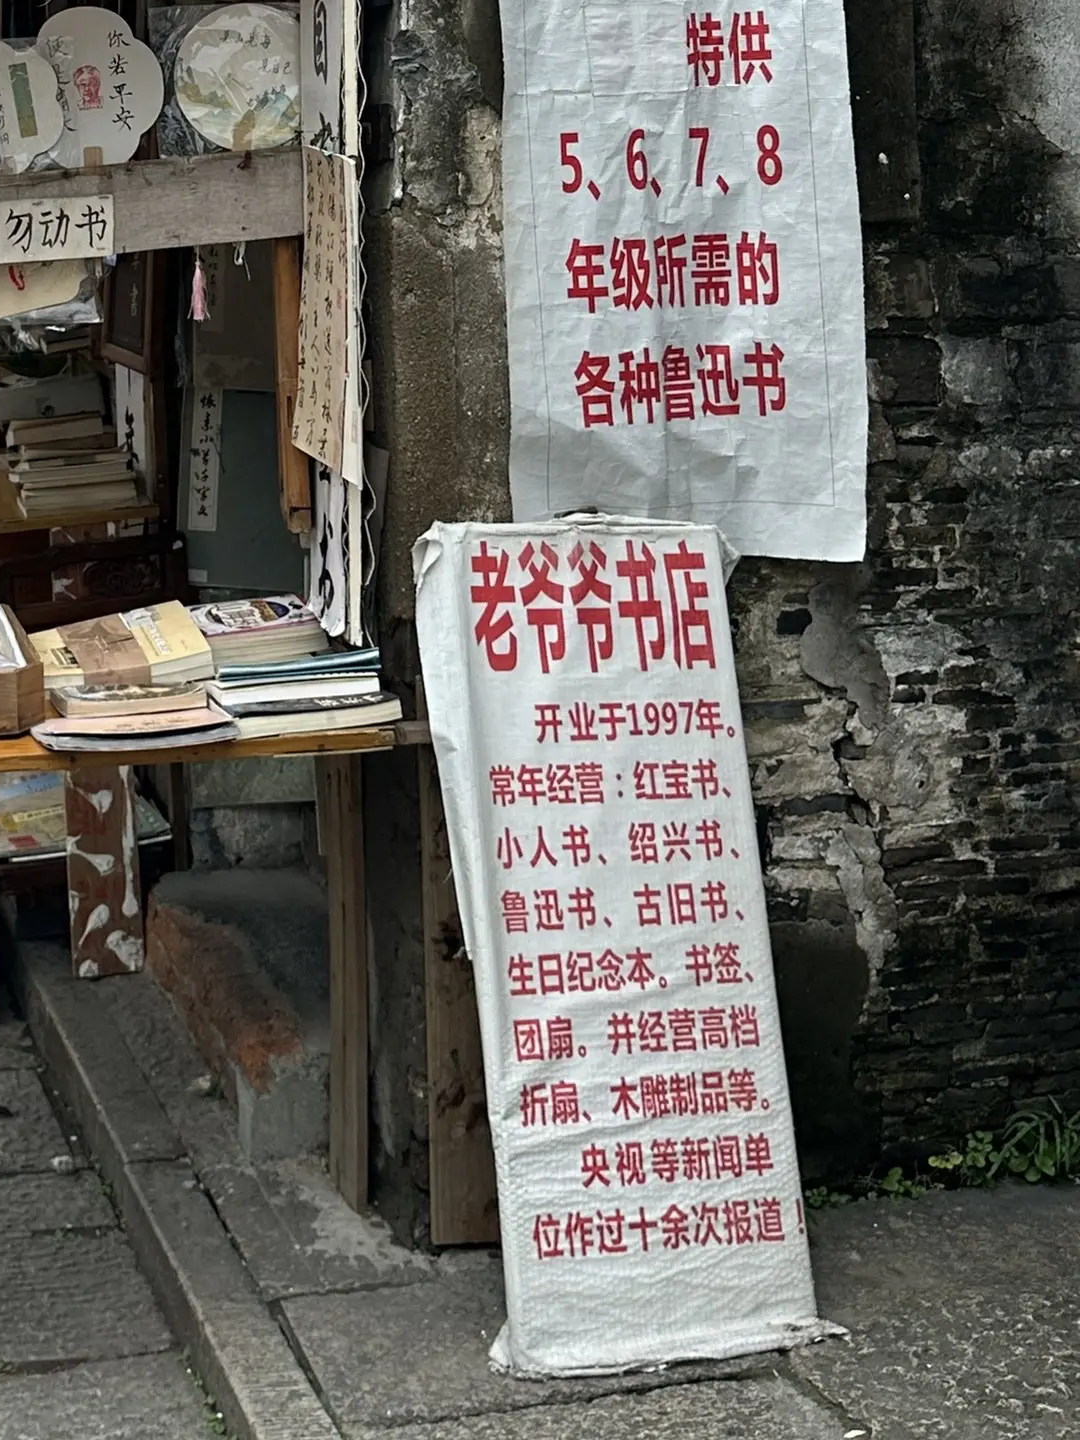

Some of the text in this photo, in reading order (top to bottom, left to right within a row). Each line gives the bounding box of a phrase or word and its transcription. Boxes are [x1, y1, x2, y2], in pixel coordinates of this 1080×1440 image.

[686, 11, 773, 87] 特供
[107, 29, 134, 131] 你若平安
[565, 231, 781, 314] 年级所需的
[573, 342, 787, 429] 各种鲁迅书
[471, 539, 717, 674] 老爷爷书店
[534, 698, 736, 743] 开业于1997年。
[496, 819, 740, 870] 小人书、绍兴书、
[501, 881, 745, 934] 鲁迅书、古旧书、
[507, 942, 755, 997] 生日纪念本。书签、
[513, 1004, 761, 1062] 团扇。并经营高档
[520, 1068, 771, 1127] 折扇、木雕制品等。
[581, 1132, 774, 1189] 央视等新闻单
